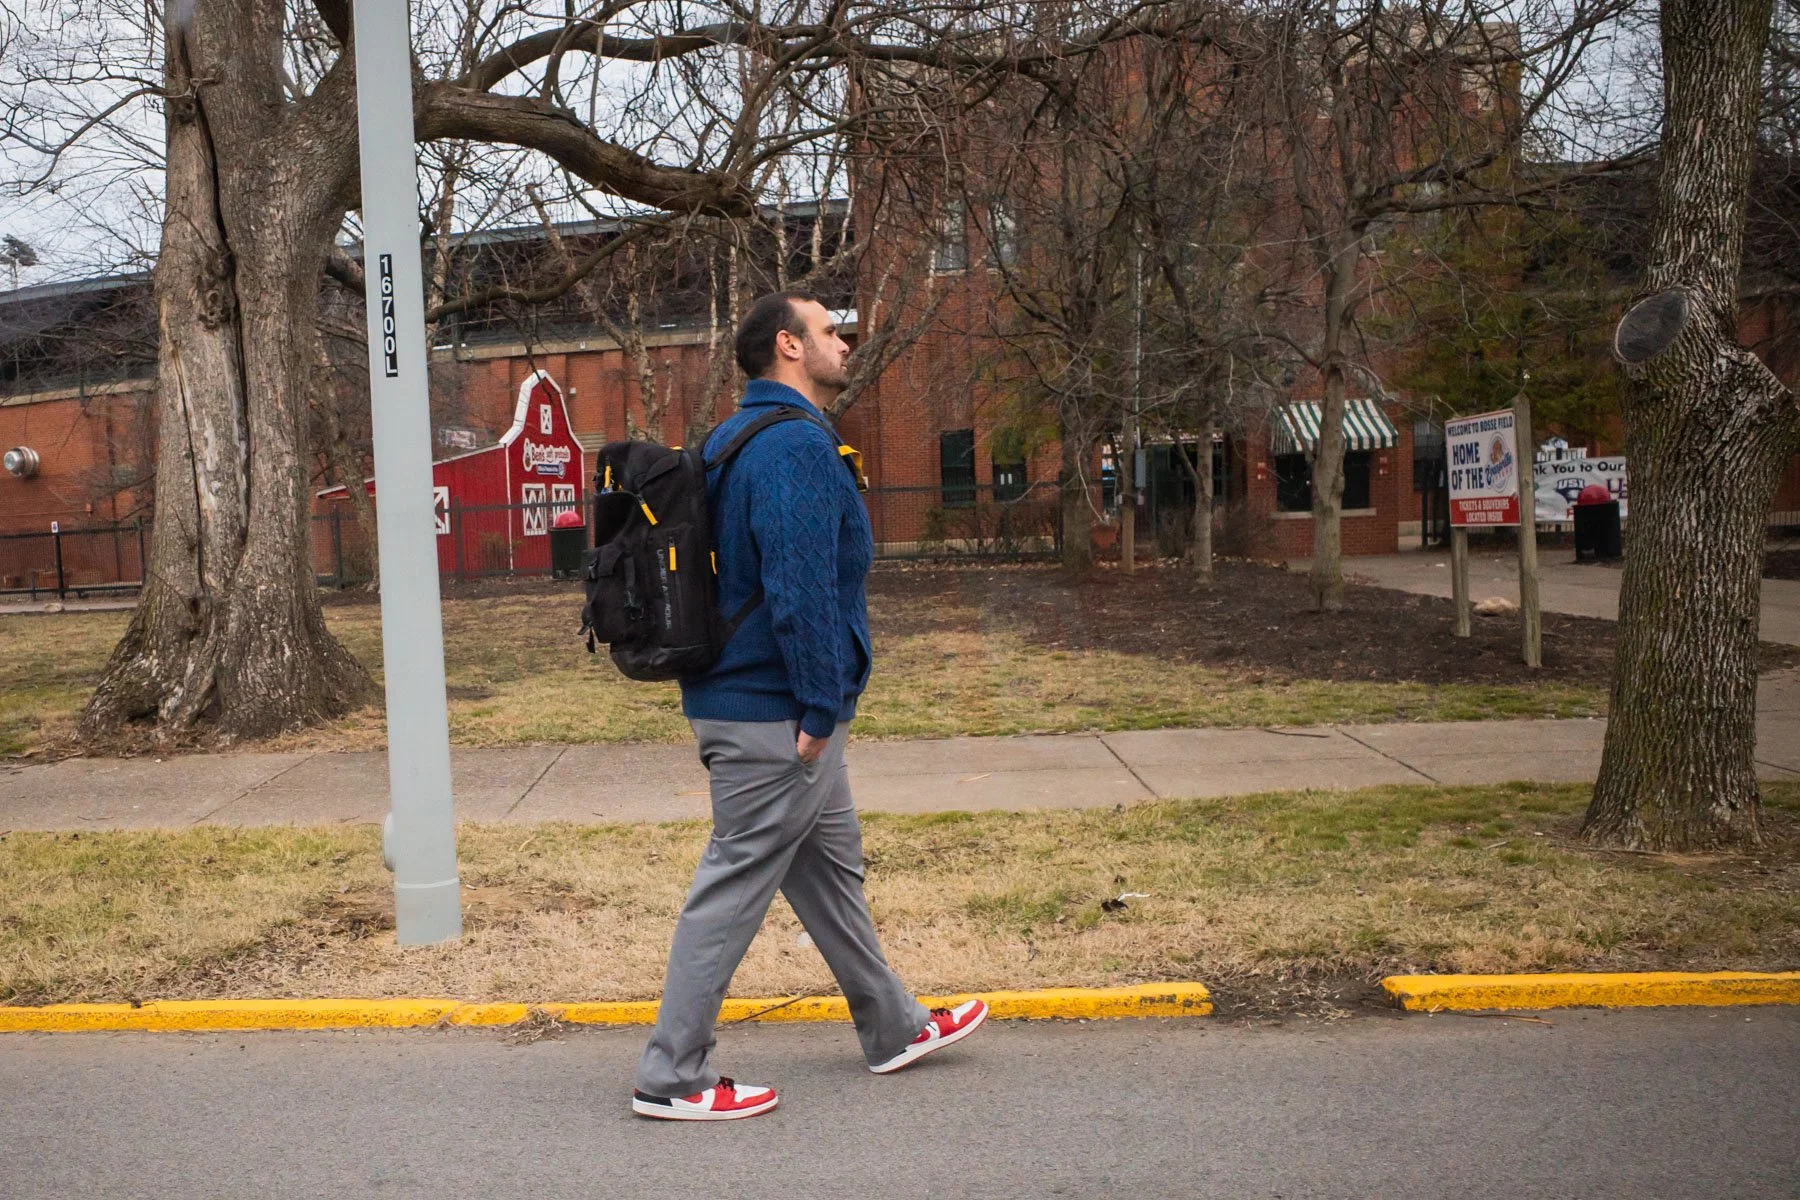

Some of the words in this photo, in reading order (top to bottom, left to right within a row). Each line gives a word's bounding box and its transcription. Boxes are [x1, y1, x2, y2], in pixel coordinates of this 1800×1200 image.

[381, 256, 397, 374] 16700L
[1447, 423, 1471, 436] WELCOME
[1472, 422, 1479, 433] TO
[1480, 418, 1497, 432] BOSSE
[1498, 416, 1513, 429] FIELD
[1452, 442, 1480, 465] HOME
[1551, 464, 1575, 473] You
[1580, 463, 1593, 472] to
[1597, 461, 1624, 471] Our
[1452, 470, 1463, 490] OF
[1465, 467, 1484, 489] THE
[1557, 479, 1585, 490] USI
[1459, 500, 1478, 511] TICKETS
[1466, 511, 1486, 522] LOCATED
[1487, 511, 1503, 522] INSIDE
[656, 549, 668, 584] UNDER
